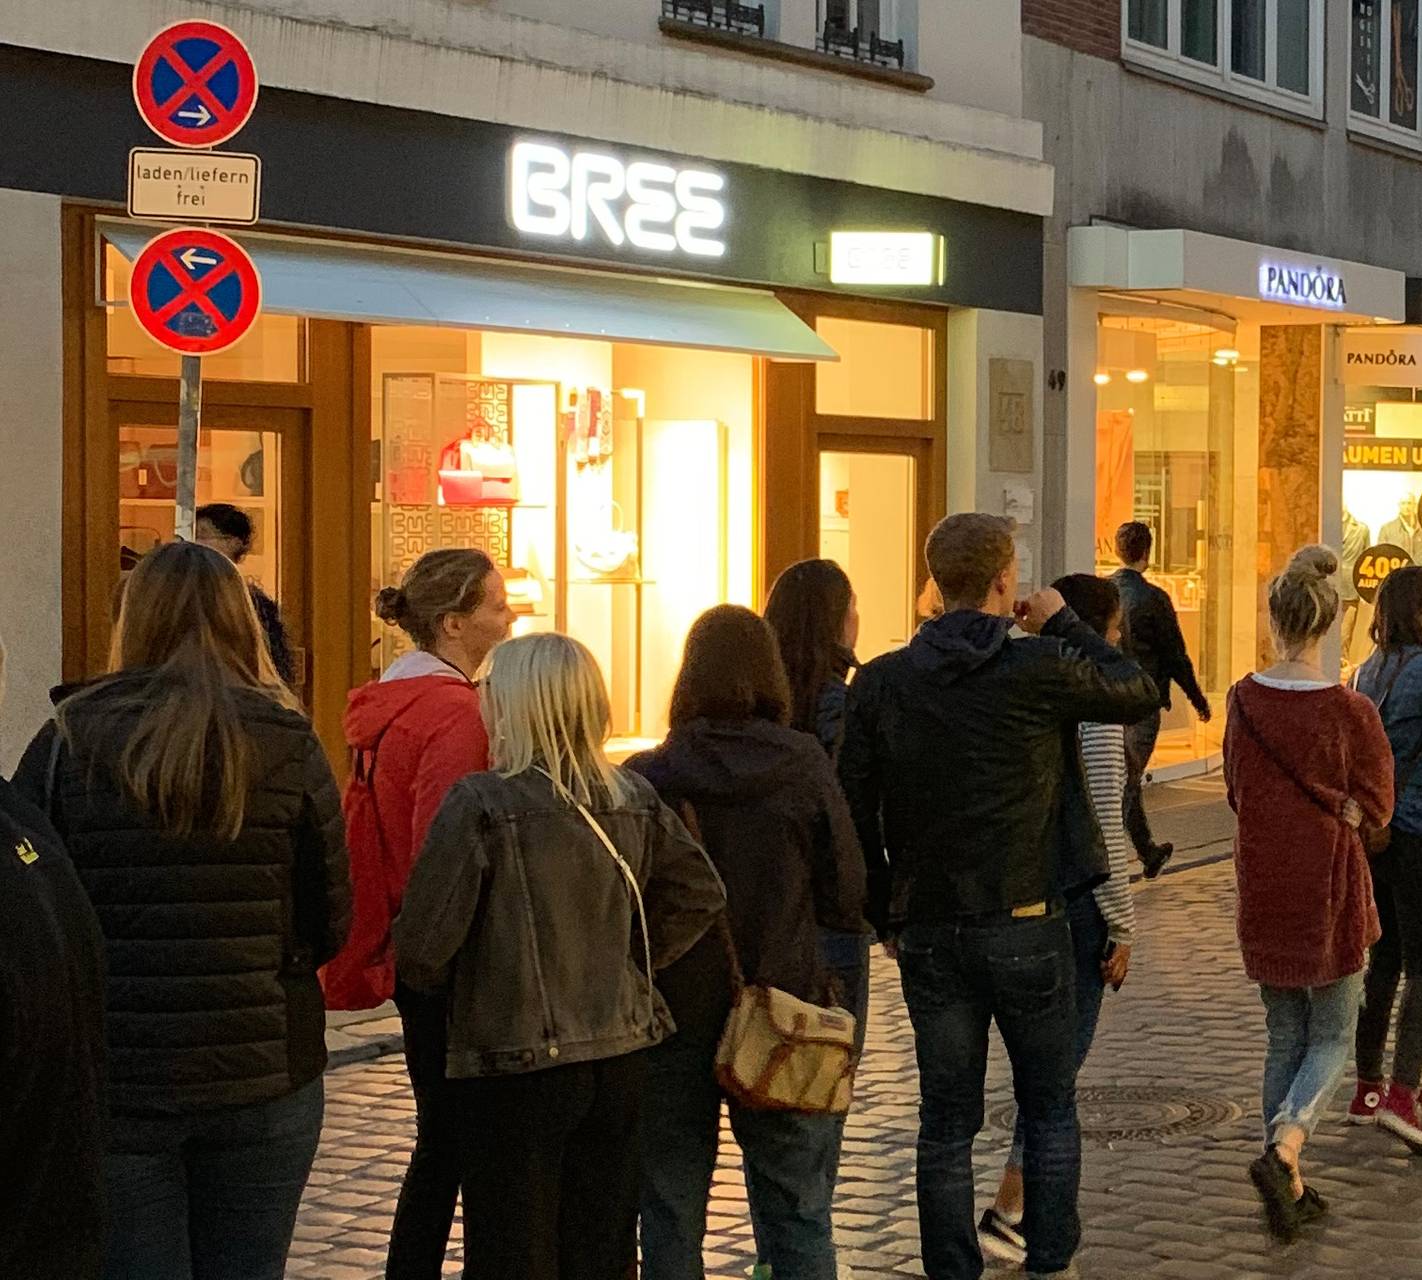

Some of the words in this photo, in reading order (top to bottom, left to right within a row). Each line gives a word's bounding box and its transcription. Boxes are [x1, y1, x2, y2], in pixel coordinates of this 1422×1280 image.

[137, 164, 249, 183] laden/liefern
[177, 190, 205, 205] frei
[512, 143, 726, 257] BREE
